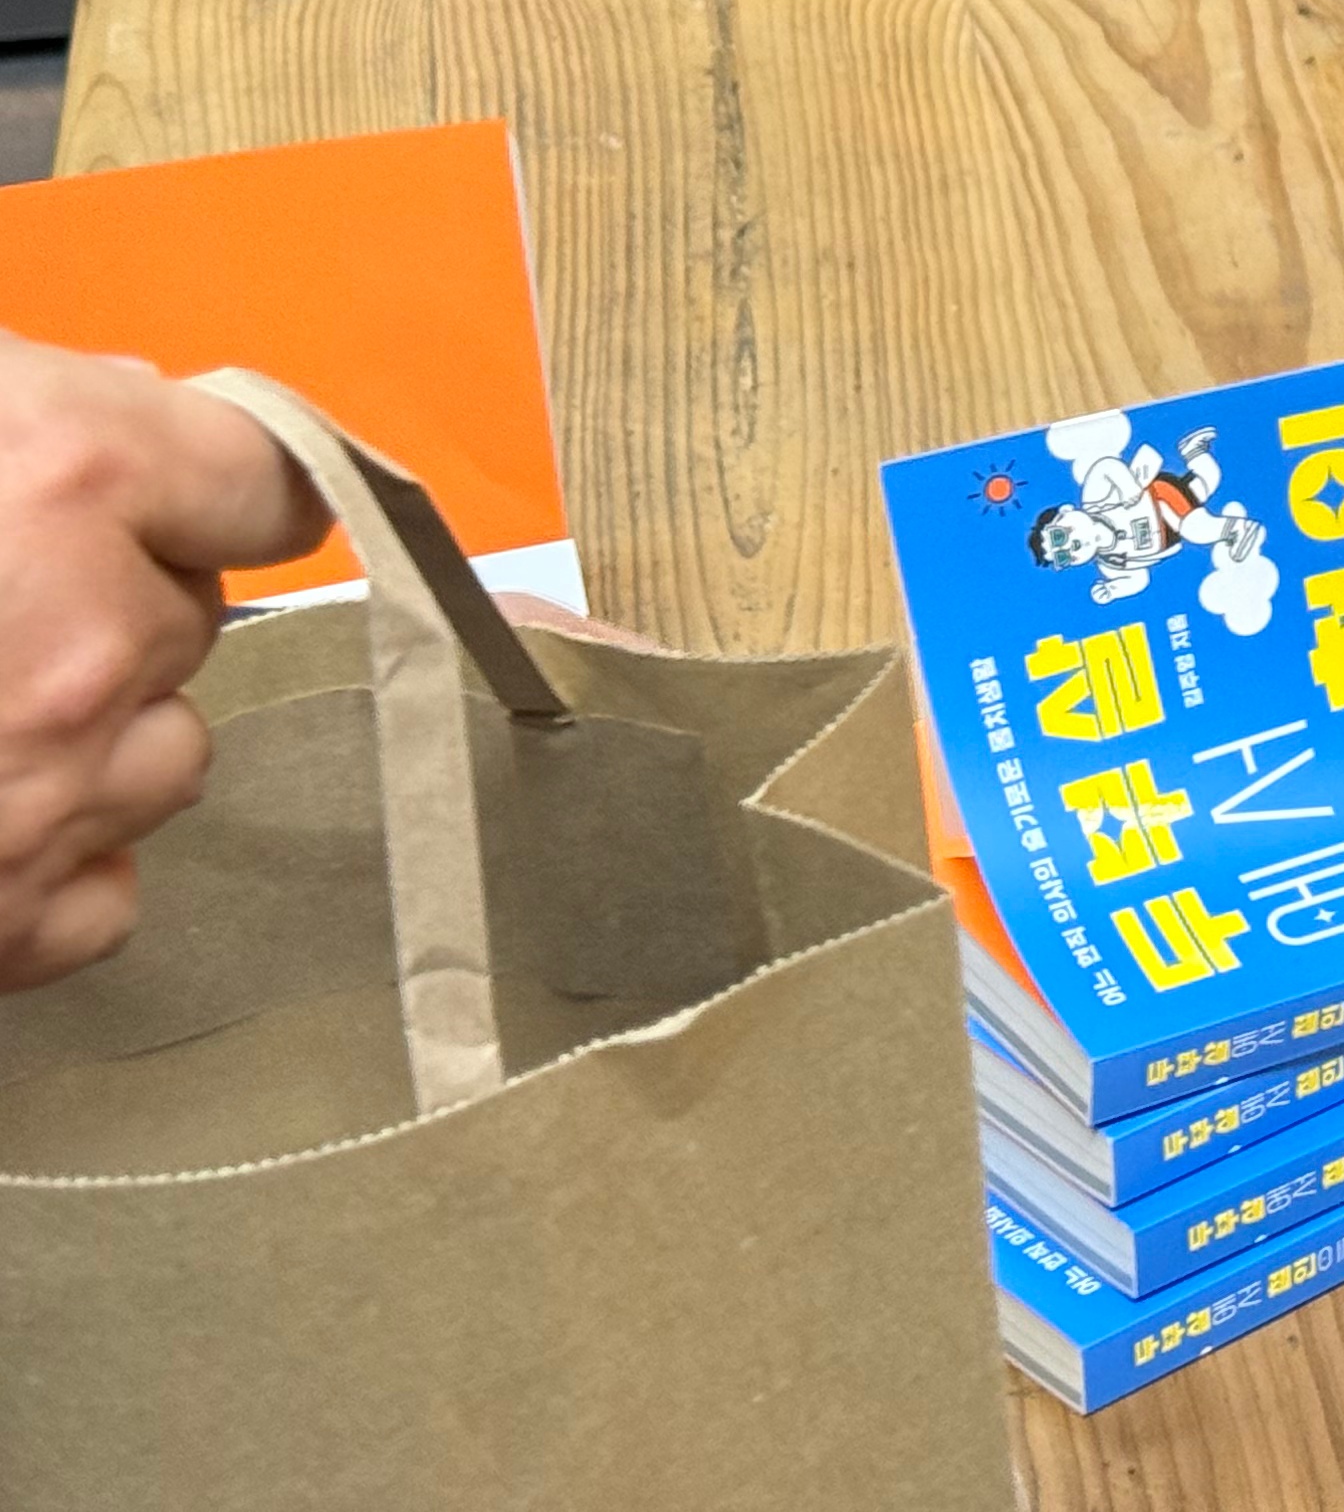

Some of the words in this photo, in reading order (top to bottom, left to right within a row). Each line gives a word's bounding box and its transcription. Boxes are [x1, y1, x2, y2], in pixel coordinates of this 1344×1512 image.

[1166, 614, 1191, 651] 지음
[970, 656, 1015, 753] 몸치생활
[997, 758, 1047, 852] 슬기로운
[1024, 621, 1251, 993] 두부살
[1029, 856, 1077, 923] 의사의
[1061, 926, 1102, 969] 현직
[1093, 968, 1127, 1006] 어느
[1022, 1240, 1068, 1271] 현직
[1064, 1265, 1102, 1295] 어느
